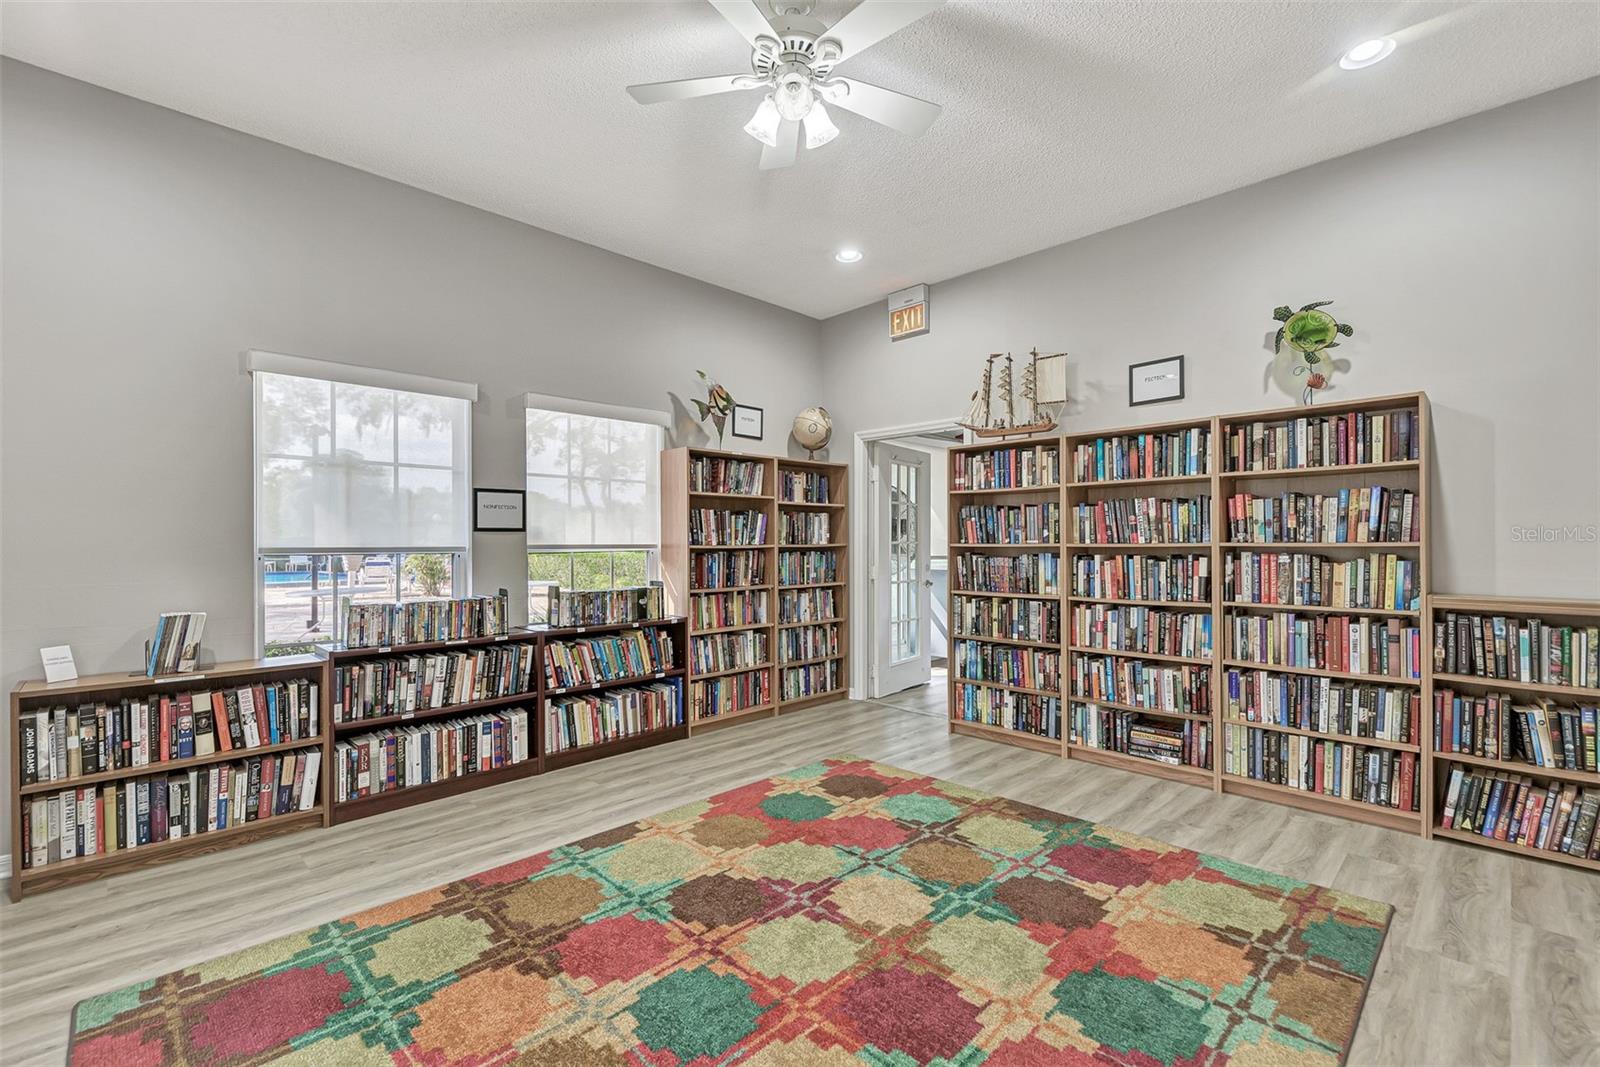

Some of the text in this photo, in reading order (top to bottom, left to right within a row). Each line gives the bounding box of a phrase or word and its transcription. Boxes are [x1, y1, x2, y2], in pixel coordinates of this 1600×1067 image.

[893, 305, 922, 332] EXIT
[26, 728, 35, 774] JOHN ADAMS
